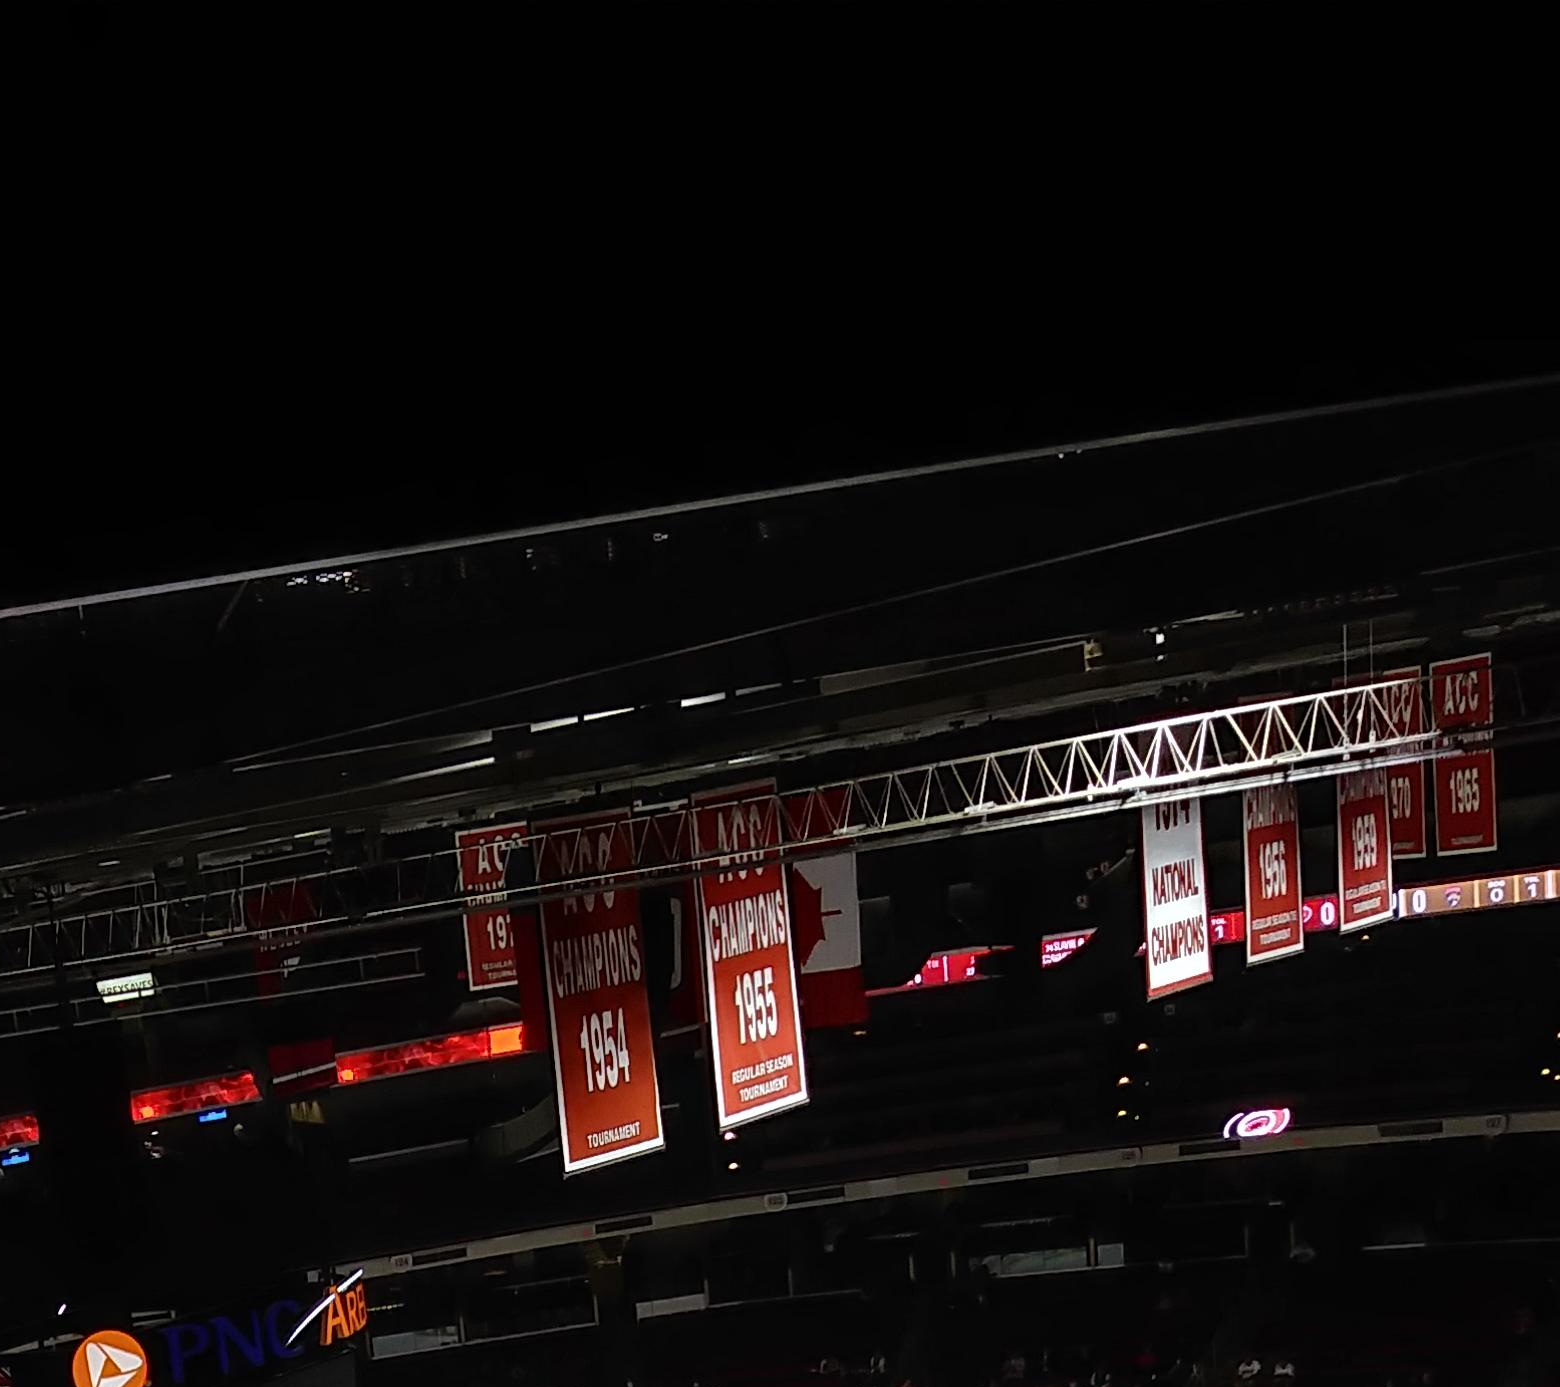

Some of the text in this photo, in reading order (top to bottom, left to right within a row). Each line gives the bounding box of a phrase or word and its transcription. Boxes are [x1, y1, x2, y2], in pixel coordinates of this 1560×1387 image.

[1444, 670, 1479, 716] ACC
[1390, 776, 1412, 820] 970
[1449, 767, 1480, 815] 1965
[1152, 858, 1199, 906] NATIONAL
[1259, 840, 1287, 899] 1956
[1412, 889, 1427, 913] 0
[708, 889, 786, 962] CHAMPIONS
[1152, 915, 1204, 966] CHAMPIONS
[553, 925, 642, 998] CHAMPIONS
[735, 966, 778, 1044] 1955
[580, 1007, 630, 1092] 1954
[732, 1054, 794, 1084] REGULAR SEASON
[740, 1075, 789, 1102] TOURNAMENT
[587, 1122, 641, 1148] TOURNAMENT
[157, 1297, 306, 1385] PNC
